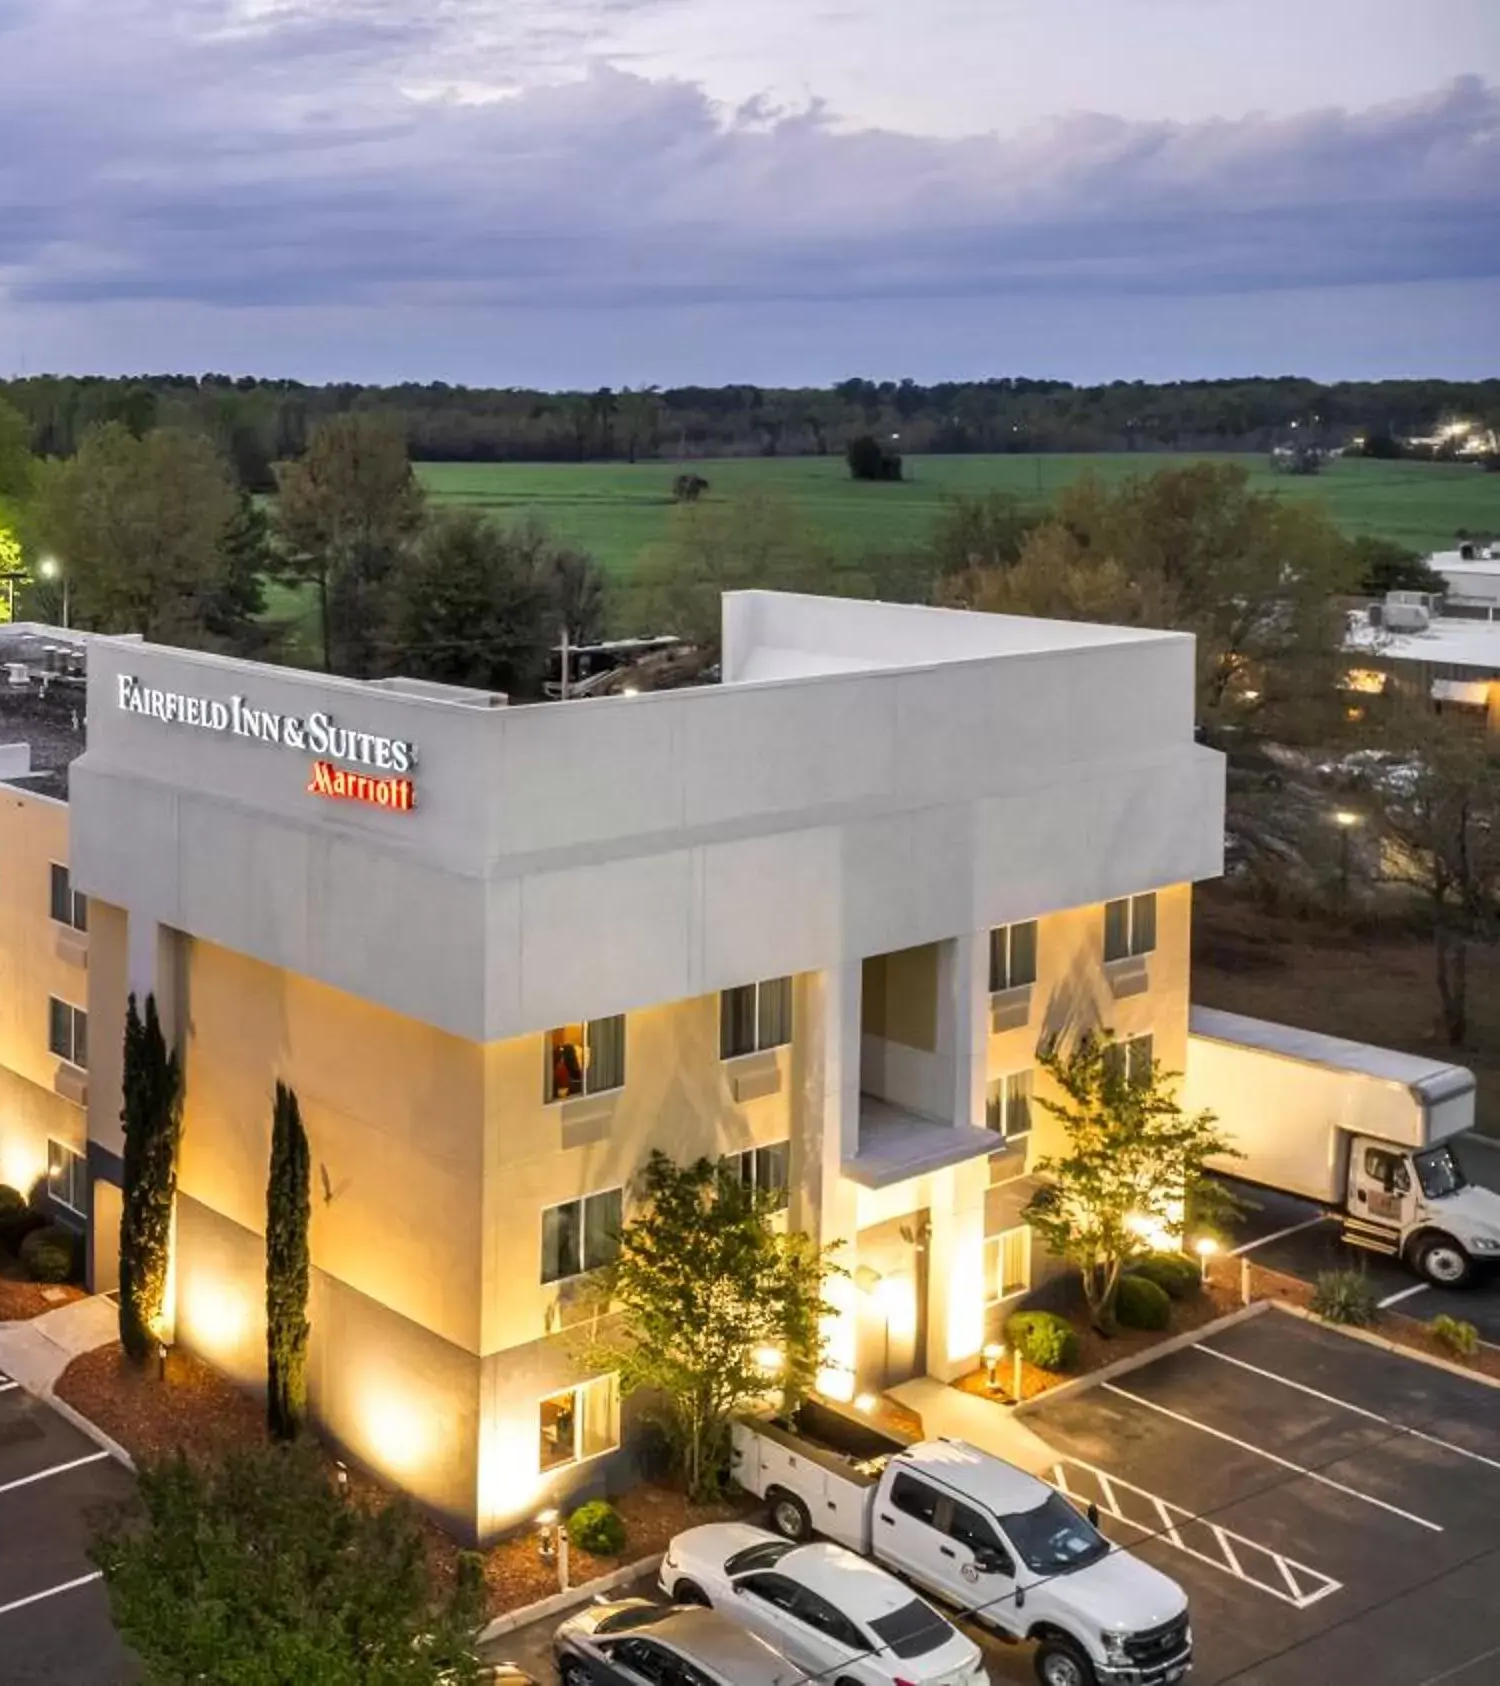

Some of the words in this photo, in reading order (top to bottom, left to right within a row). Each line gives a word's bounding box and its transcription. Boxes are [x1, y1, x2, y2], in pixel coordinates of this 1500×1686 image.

[117, 673, 228, 731] FAIRFIELD
[231, 694, 281, 742] INN
[283, 717, 305, 750] &
[306, 711, 409, 772] SUITES
[307, 760, 415, 812] Marriott
